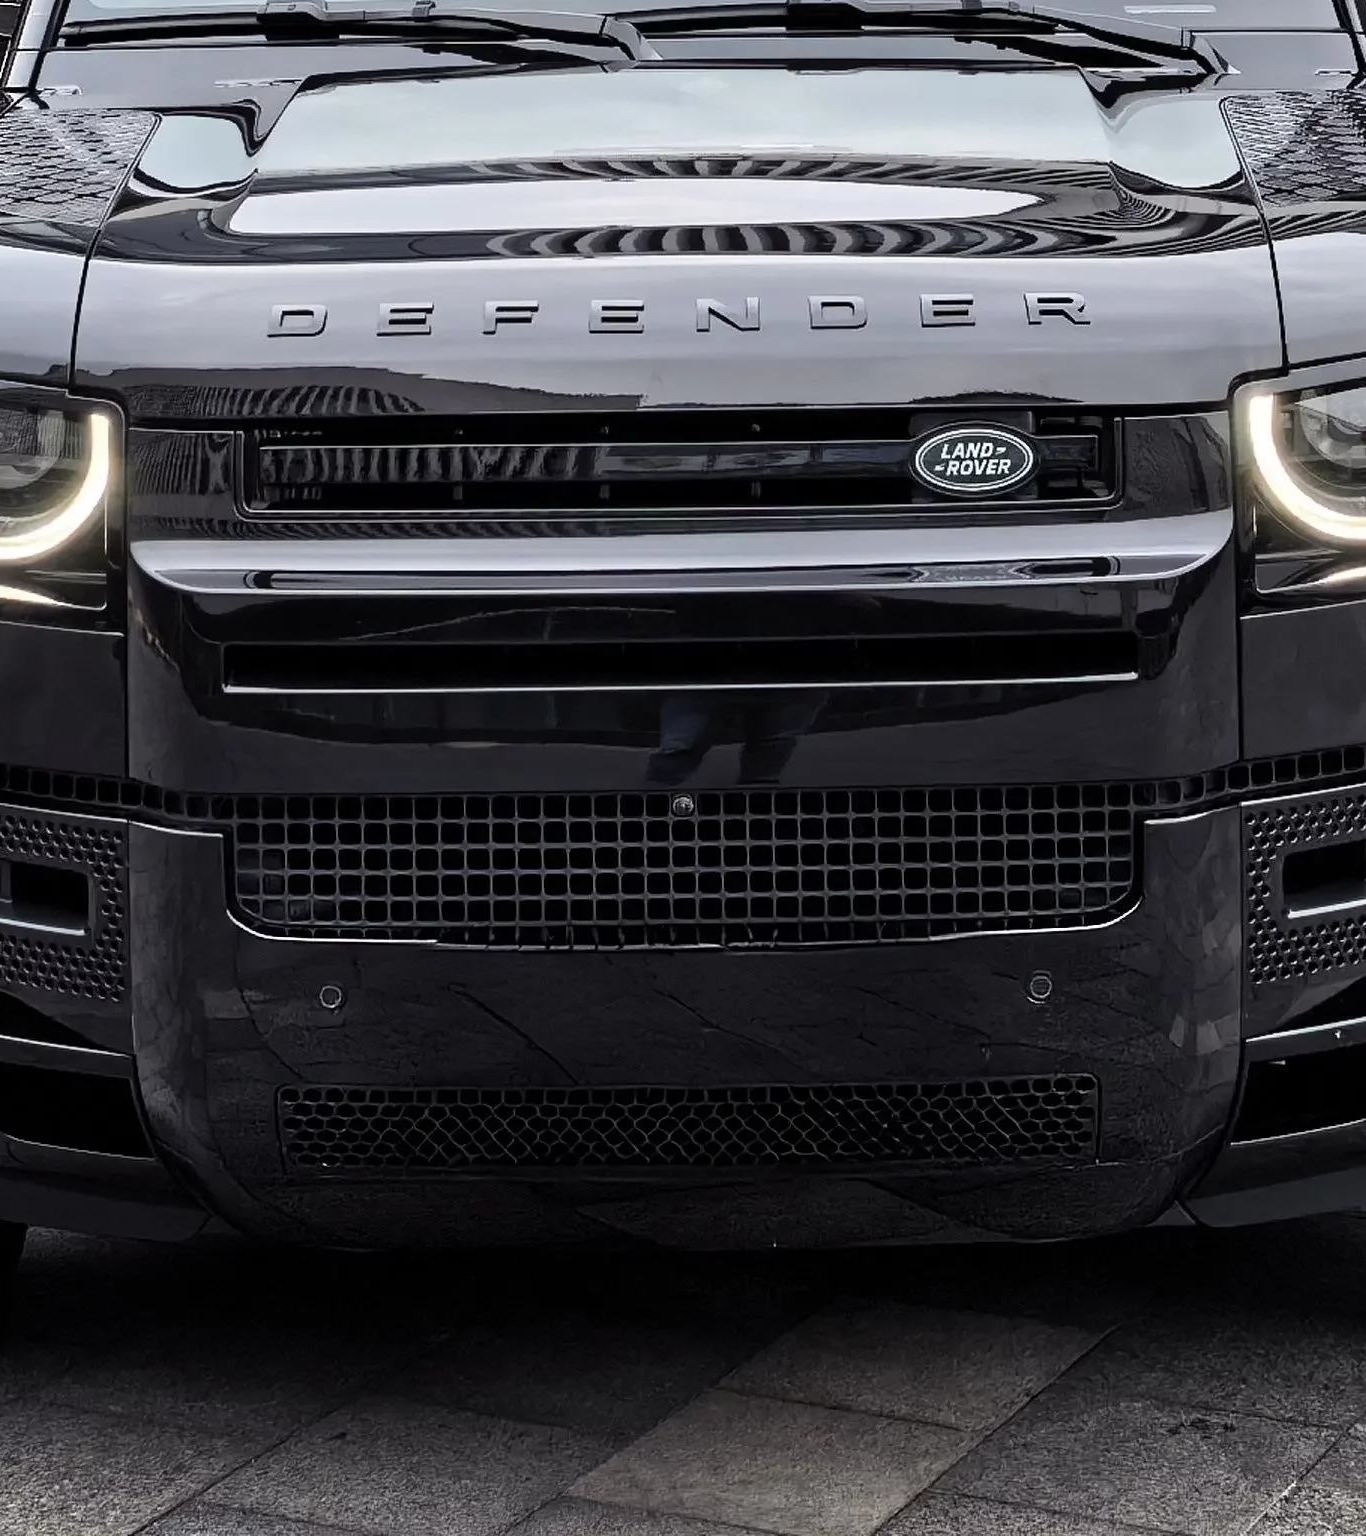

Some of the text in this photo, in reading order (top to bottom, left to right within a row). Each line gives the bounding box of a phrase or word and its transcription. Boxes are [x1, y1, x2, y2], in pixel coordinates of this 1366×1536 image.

[266, 290, 1091, 337] DEFENDER
[941, 442, 993, 459] LAND
[946, 459, 1011, 476] ROVER
